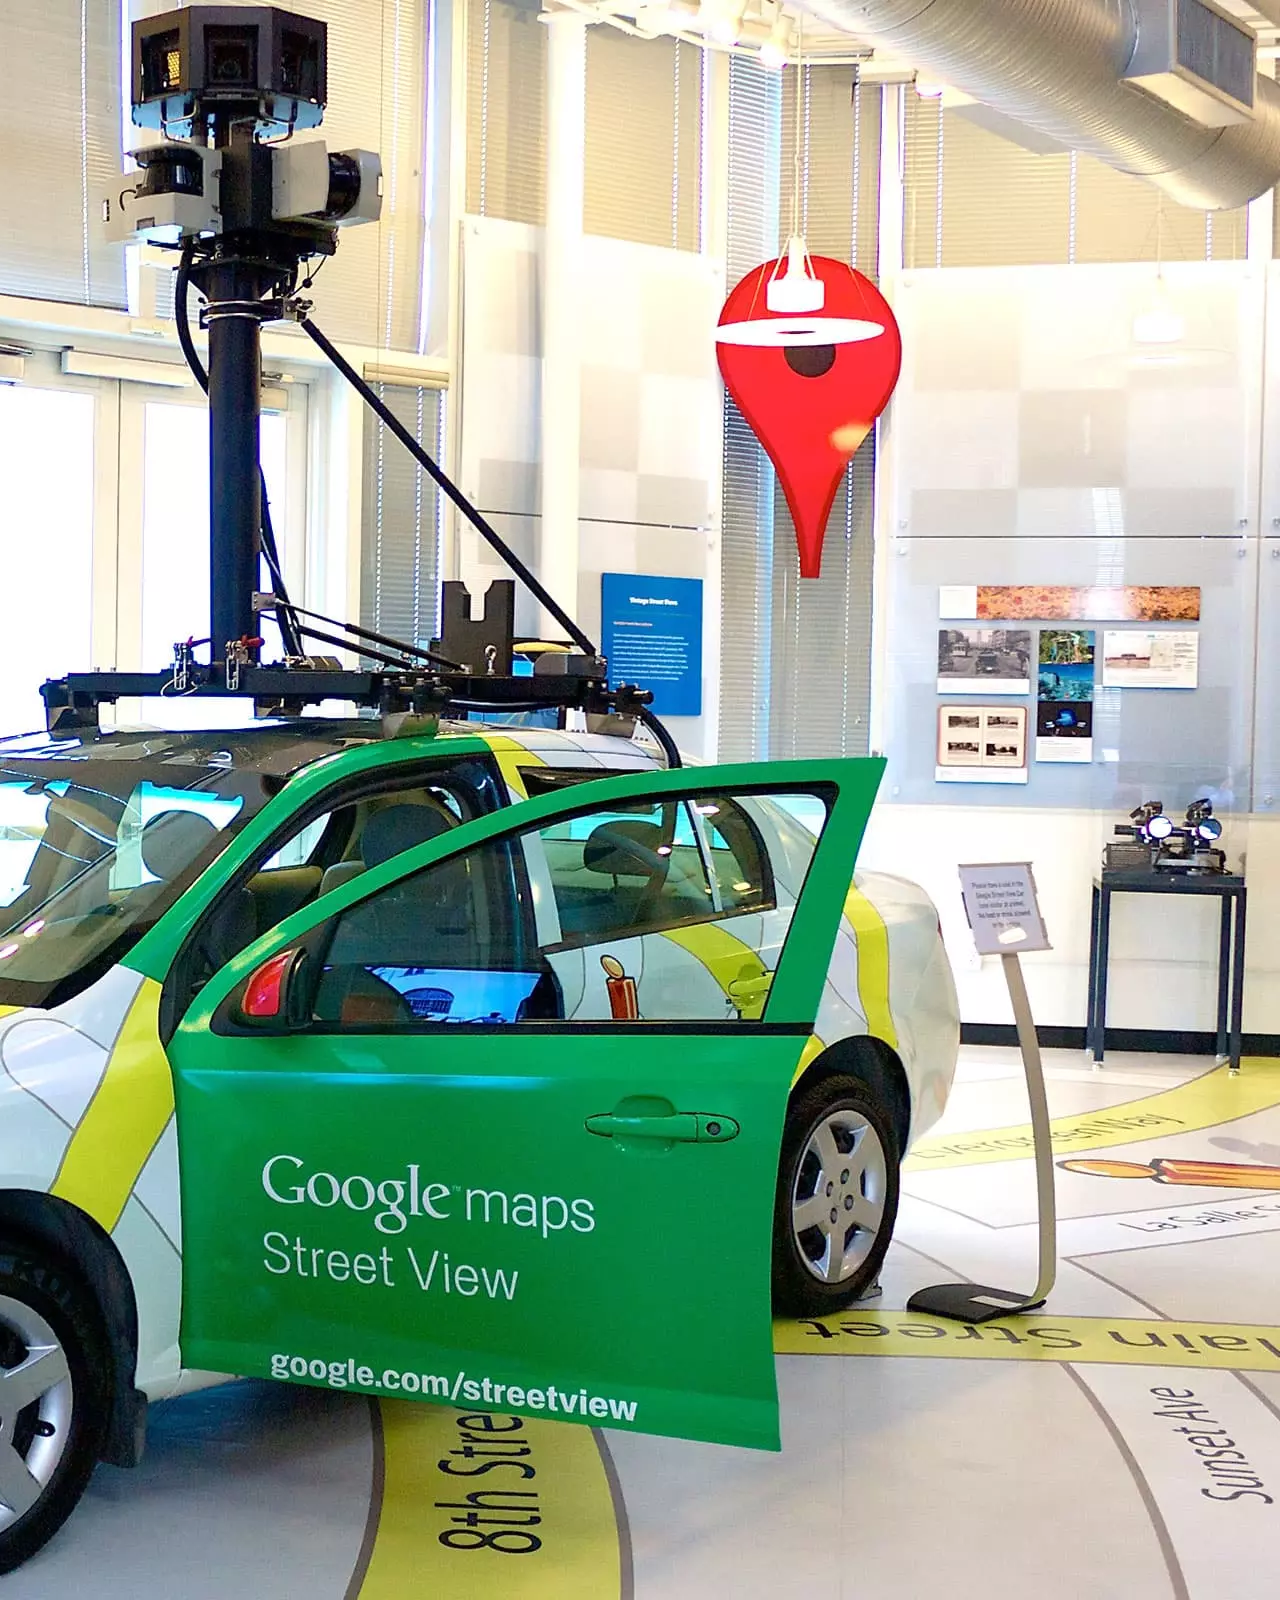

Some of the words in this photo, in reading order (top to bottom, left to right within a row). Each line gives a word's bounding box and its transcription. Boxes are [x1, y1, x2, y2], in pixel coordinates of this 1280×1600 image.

[261, 1154, 451, 1234] Google
[465, 1187, 596, 1239] maps
[262, 1231, 395, 1288] Street
[407, 1247, 520, 1301] View
[798, 1319, 1083, 1349] Street
[270, 1353, 639, 1423] google.com/streetview
[1149, 1386, 1219, 1424] Ave
[437, 1406, 537, 1480] Stre
[1172, 1426, 1274, 1505] Sunset
[434, 1490, 543, 1554] 8th
